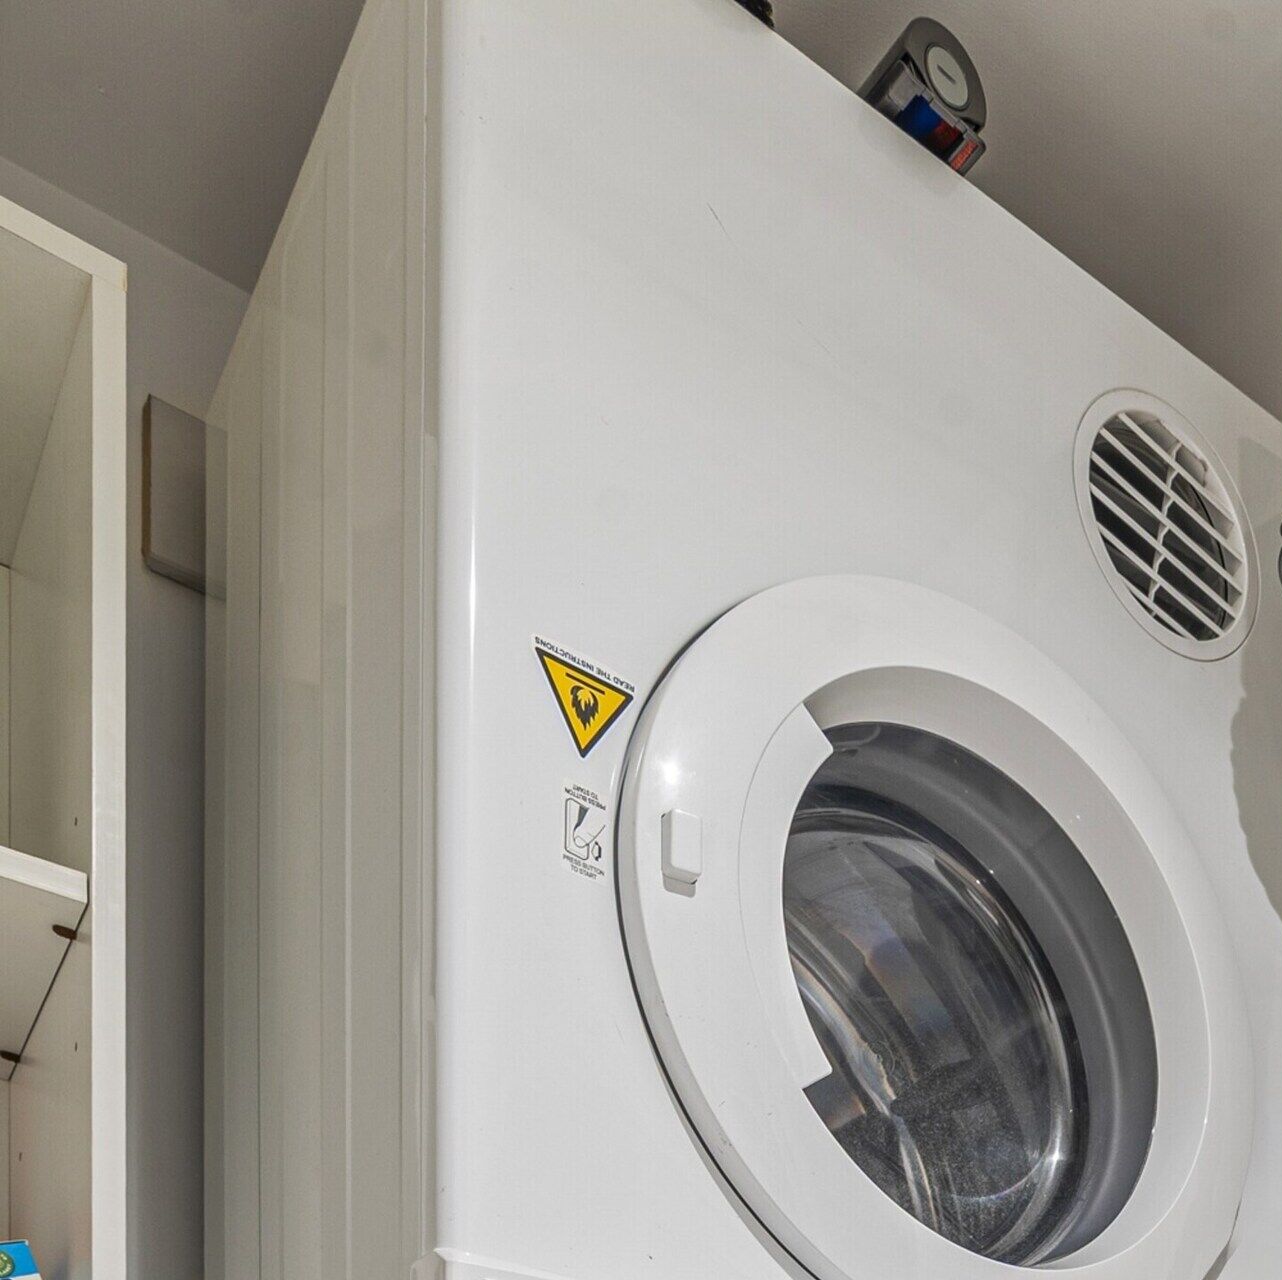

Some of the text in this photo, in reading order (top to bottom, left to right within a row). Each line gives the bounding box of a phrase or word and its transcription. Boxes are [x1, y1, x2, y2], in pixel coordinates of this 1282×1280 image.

[534, 636, 635, 693] READ THE INSTRUCTIONS
[562, 853, 605, 876] PRESS BUTTON
[571, 864, 597, 880] TO START
